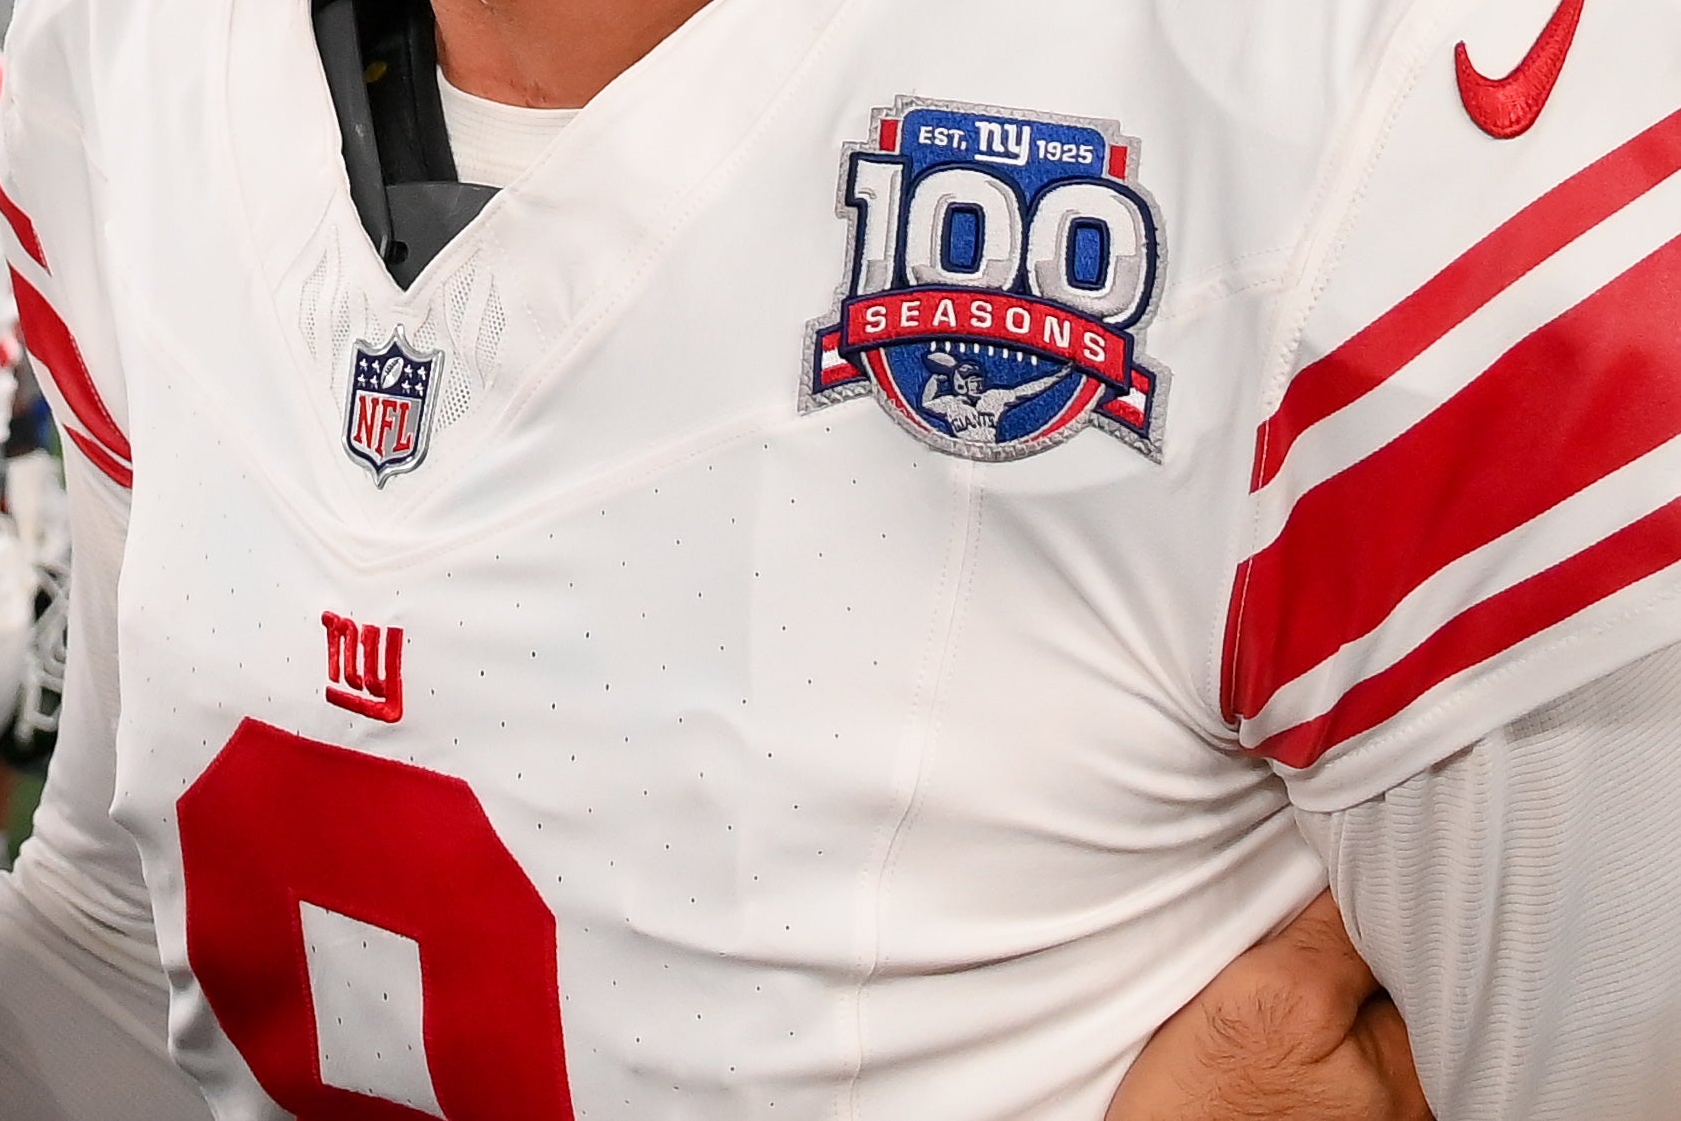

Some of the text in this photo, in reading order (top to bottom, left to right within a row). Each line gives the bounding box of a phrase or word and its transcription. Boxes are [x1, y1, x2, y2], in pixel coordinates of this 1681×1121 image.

[1036, 140, 1093, 164] 1925
[846, 152, 1158, 329] 100
[864, 299, 1107, 363] SEASONS
[353, 394, 413, 458] NFL
